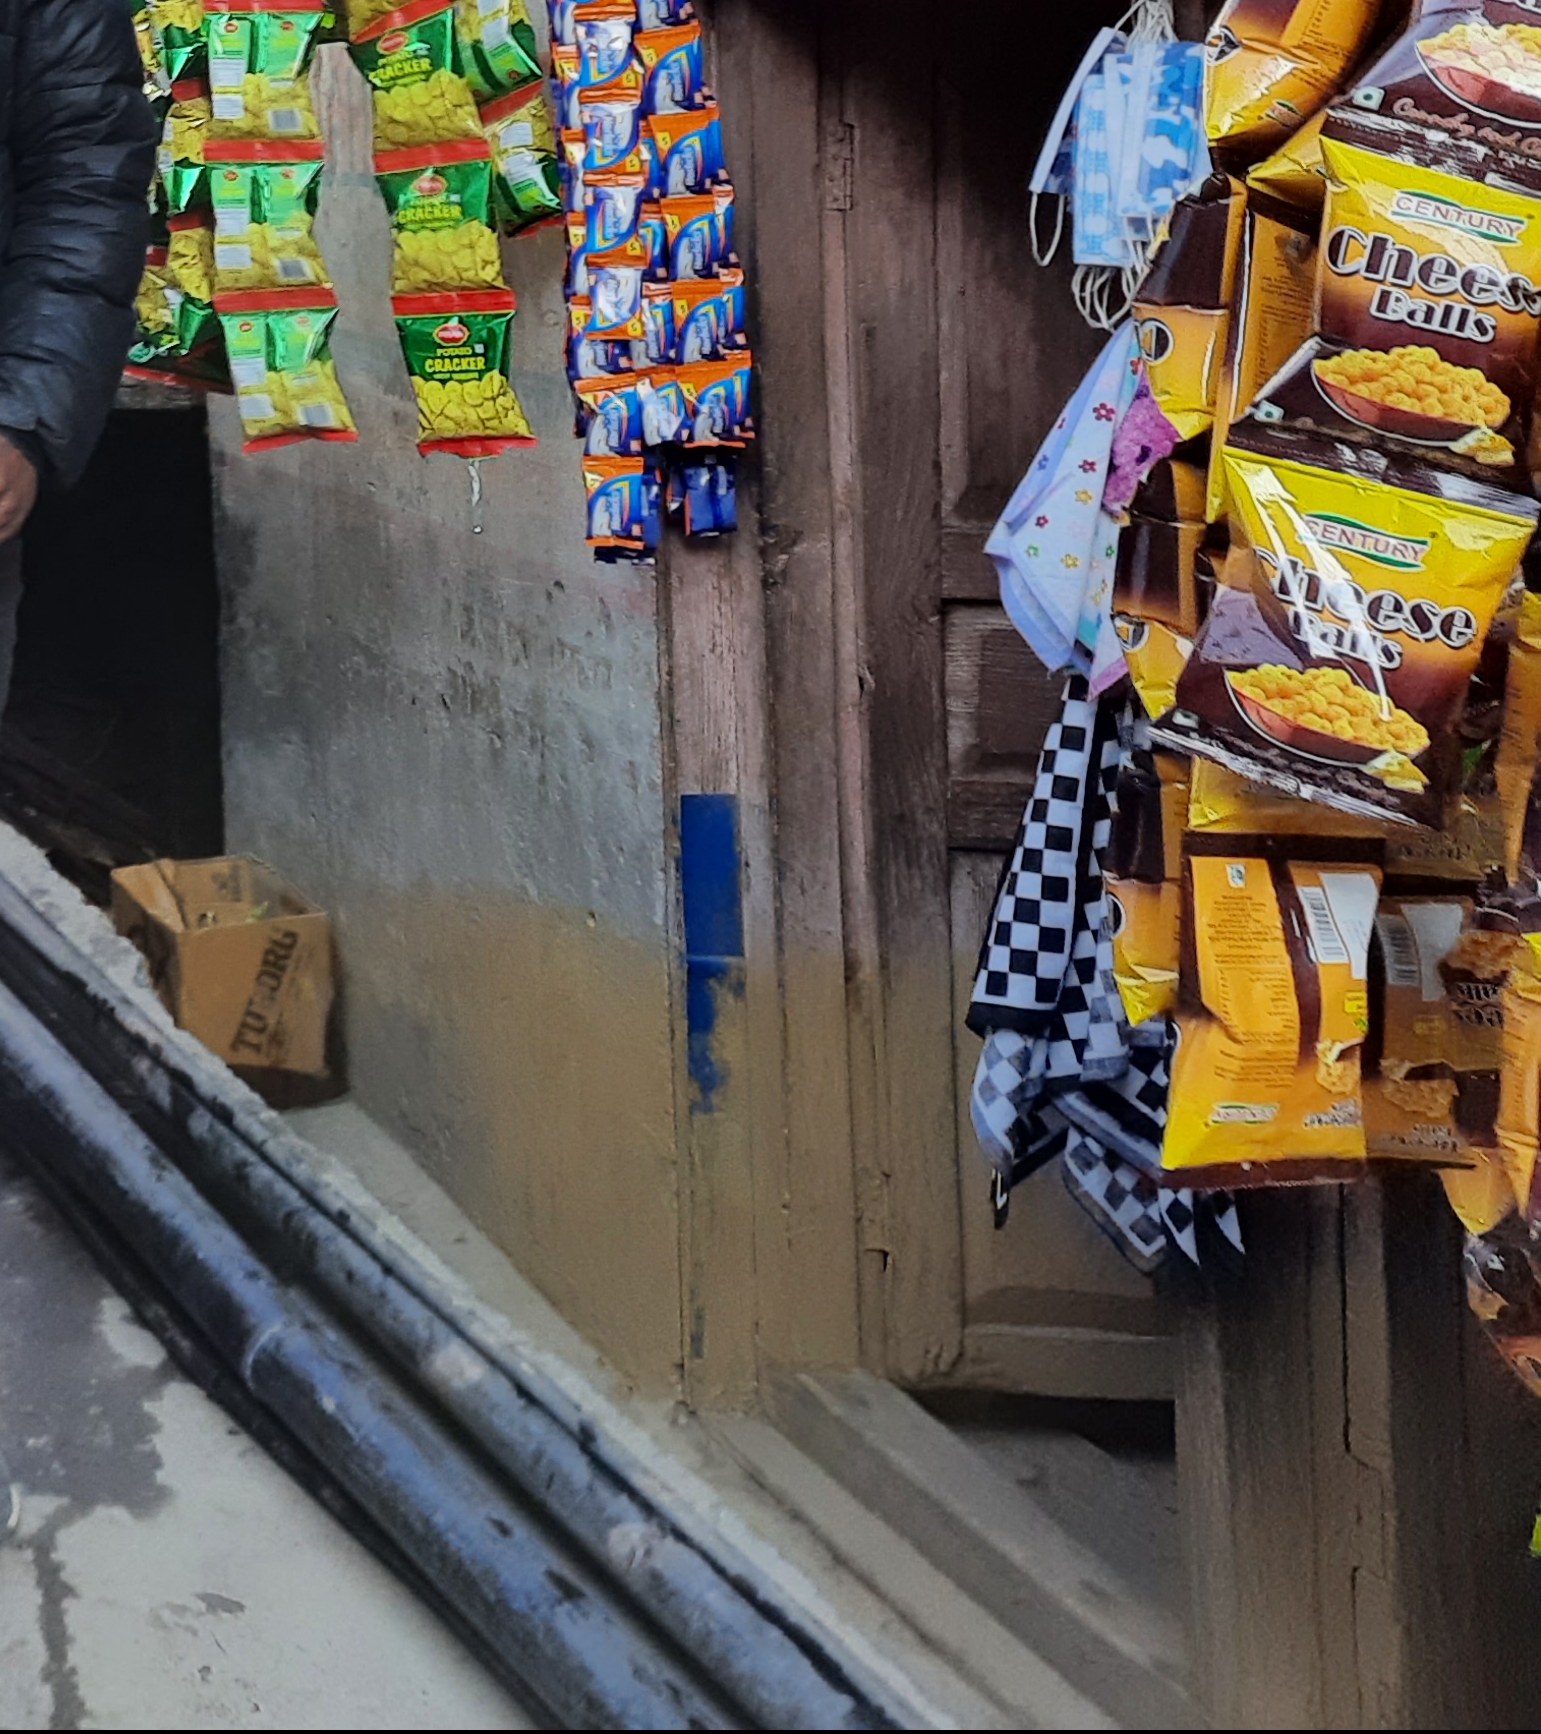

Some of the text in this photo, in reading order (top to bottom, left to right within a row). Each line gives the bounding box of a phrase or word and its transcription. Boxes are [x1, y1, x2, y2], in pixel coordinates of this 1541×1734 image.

[1394, 195, 1522, 240] CENTURY
[1369, 286, 1498, 344] Balls
[424, 356, 486, 373] CRACKER
